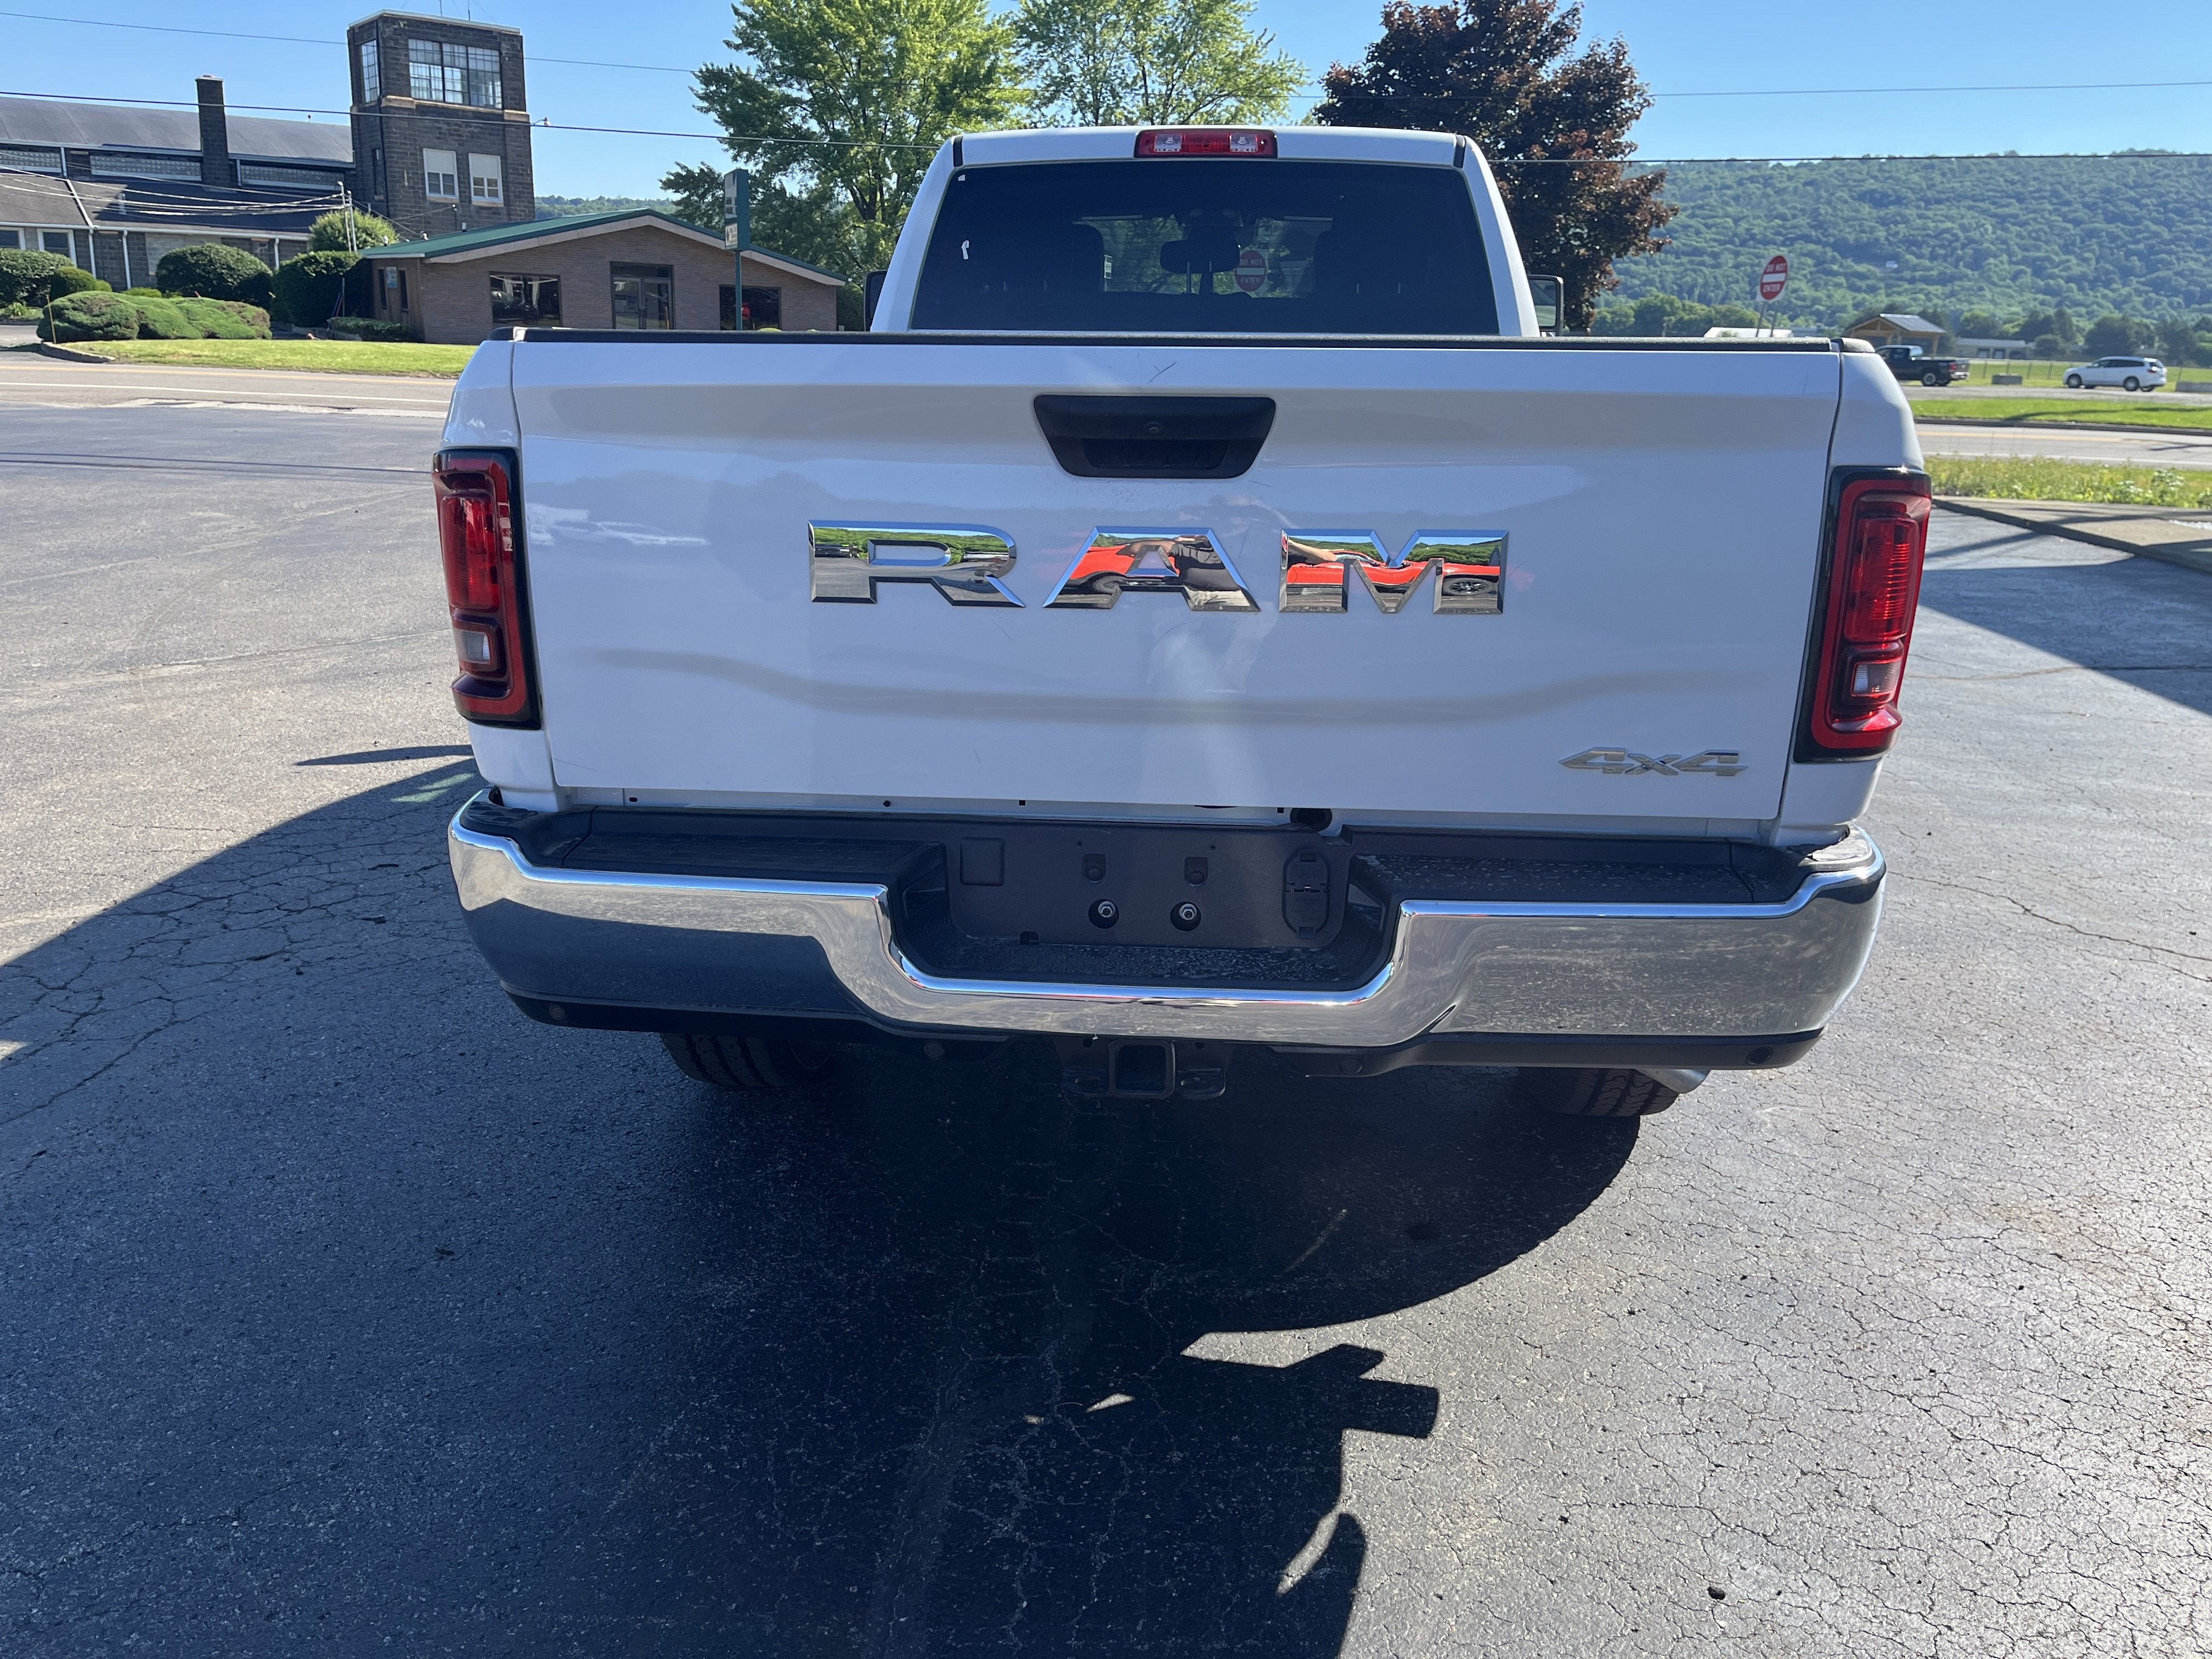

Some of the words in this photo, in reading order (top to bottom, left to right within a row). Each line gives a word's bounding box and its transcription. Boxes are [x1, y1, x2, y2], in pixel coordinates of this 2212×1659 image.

[1776, 263, 1787, 272] NOT
[1763, 284, 1781, 292] ENTER
[808, 520, 1510, 614] RAM
